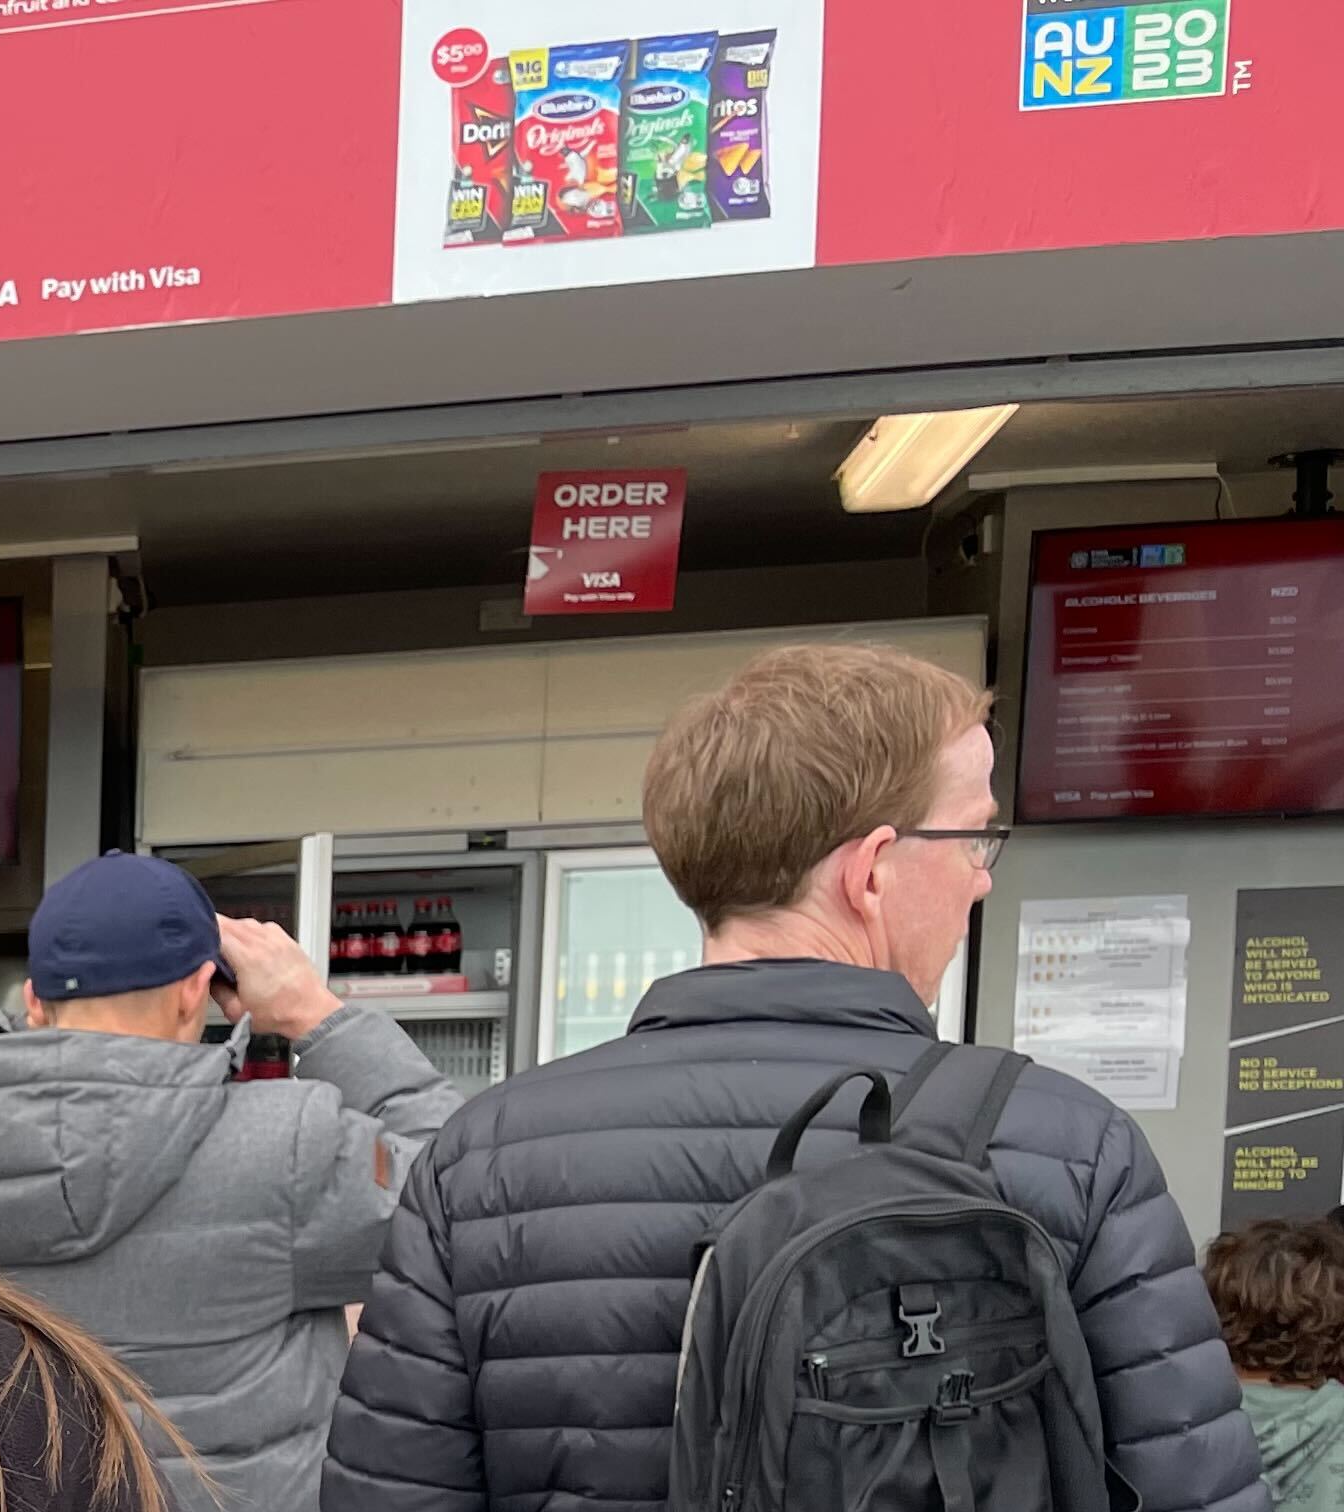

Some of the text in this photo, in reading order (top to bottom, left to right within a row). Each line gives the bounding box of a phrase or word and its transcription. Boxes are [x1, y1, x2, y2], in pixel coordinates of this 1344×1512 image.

[1034, 16, 1115, 60] AU
[514, 61, 543, 77] BIG
[1032, 56, 1113, 99] NZ
[1231, 59, 1253, 96] TM
[526, 117, 605, 156] Originals
[453, 187, 484, 202] WIN
[514, 184, 544, 199] WIN
[41, 278, 86, 303] Pay
[90, 269, 146, 297] with
[148, 264, 201, 290] Visa
[554, 481, 669, 509] ORDER
[562, 514, 652, 540] HERE
[581, 571, 622, 588] VISA
[1246, 935, 1308, 949] ALCOHOL
[1246, 947, 1309, 959] WILL NOT
[1245, 957, 1318, 970] BE SERVED
[1245, 969, 1322, 981] TO ANYONE
[1244, 981, 1293, 993] WHO IS
[1243, 990, 1330, 1004] INTOXICATED
[1239, 1056, 1278, 1069] NO ID
[1239, 1067, 1318, 1080] NO SERVICE
[1238, 1078, 1344, 1091] NO EXCEPTIONS
[1235, 1146, 1297, 1158] ALCOHOL
[1235, 1158, 1267, 1169] WILL
[1288, 1168, 1307, 1180] TO
